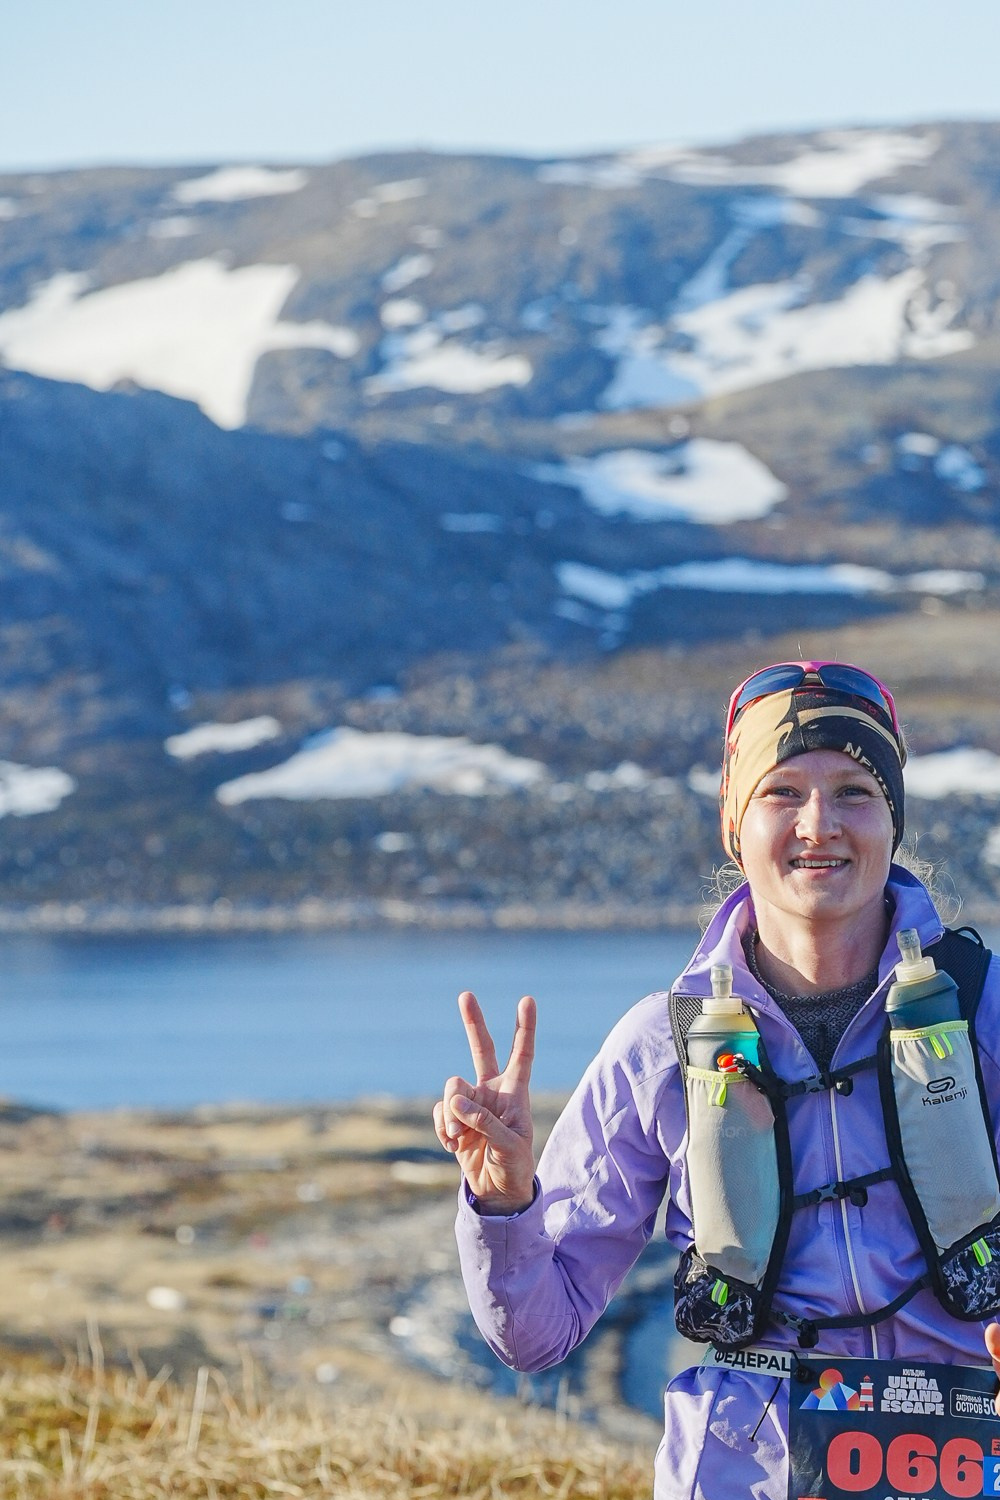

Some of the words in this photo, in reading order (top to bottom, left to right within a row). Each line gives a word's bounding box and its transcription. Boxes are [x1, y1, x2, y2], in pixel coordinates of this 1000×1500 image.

[921, 1087, 968, 1107] Kalenji
[888, 1375, 939, 1391] ULTRA
[883, 1388, 943, 1403] GRAND
[880, 1400, 945, 1416] ESCAPE
[955, 1402, 983, 1415] ОСТРОВ
[827, 1431, 984, 1498] 066
